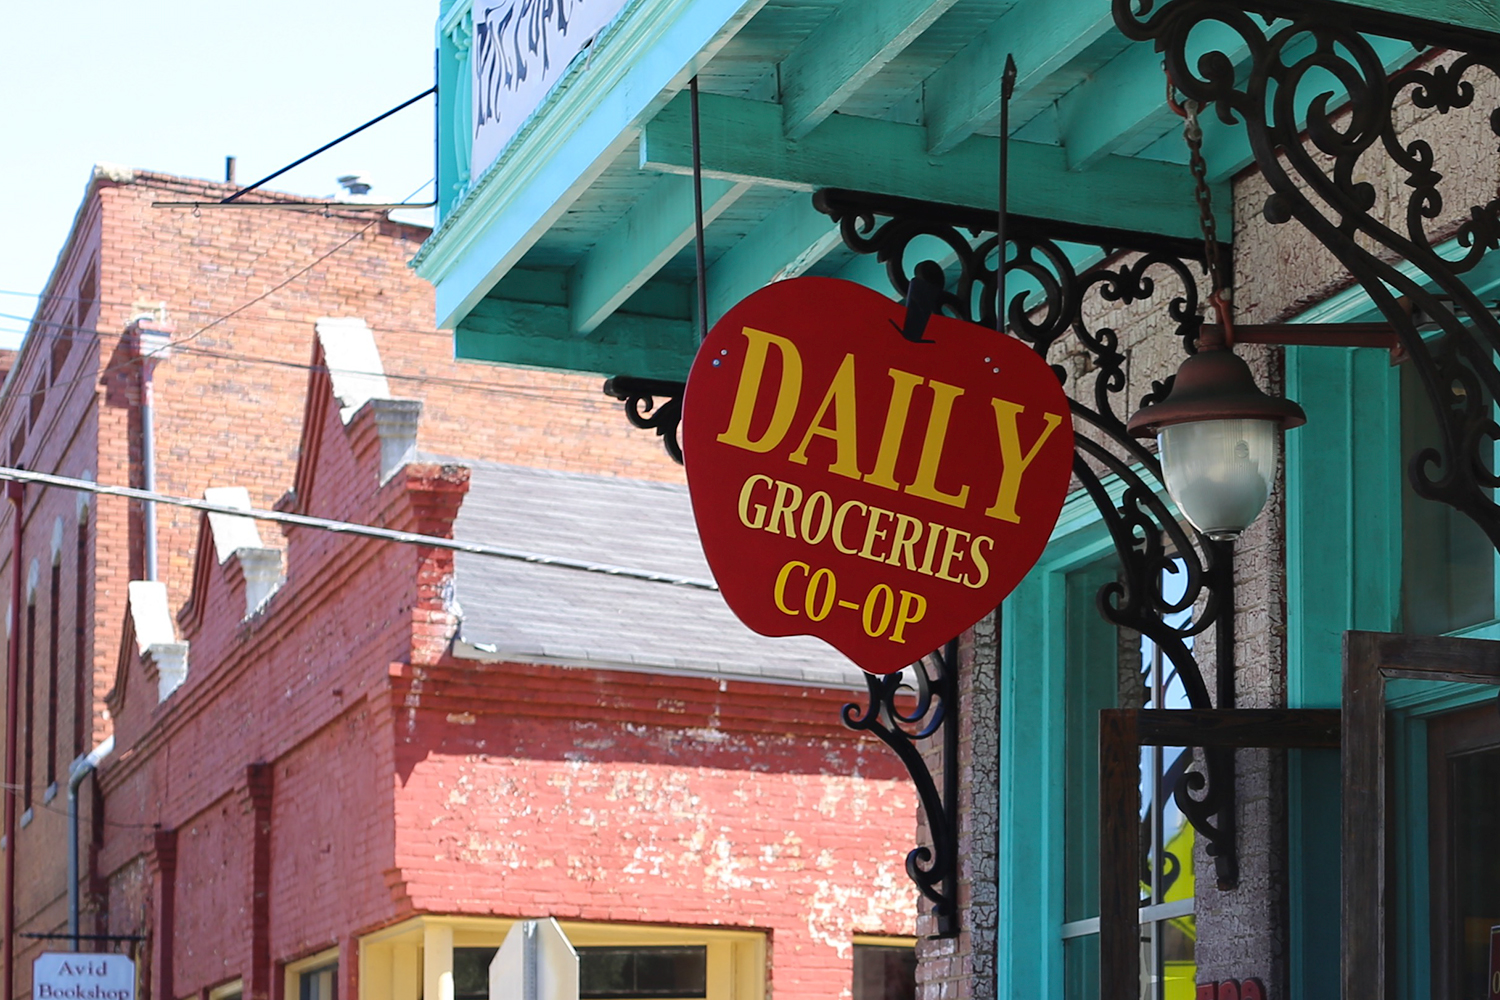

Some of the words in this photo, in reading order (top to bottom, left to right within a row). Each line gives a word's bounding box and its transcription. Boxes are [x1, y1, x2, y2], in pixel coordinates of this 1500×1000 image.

[716, 326, 1062, 525] DAILY
[738, 474, 995, 589] GROCERIES
[774, 560, 928, 644] CO-OP
[39, 984, 129, 1000] Bookshop
[58, 961, 107, 976] Avid
